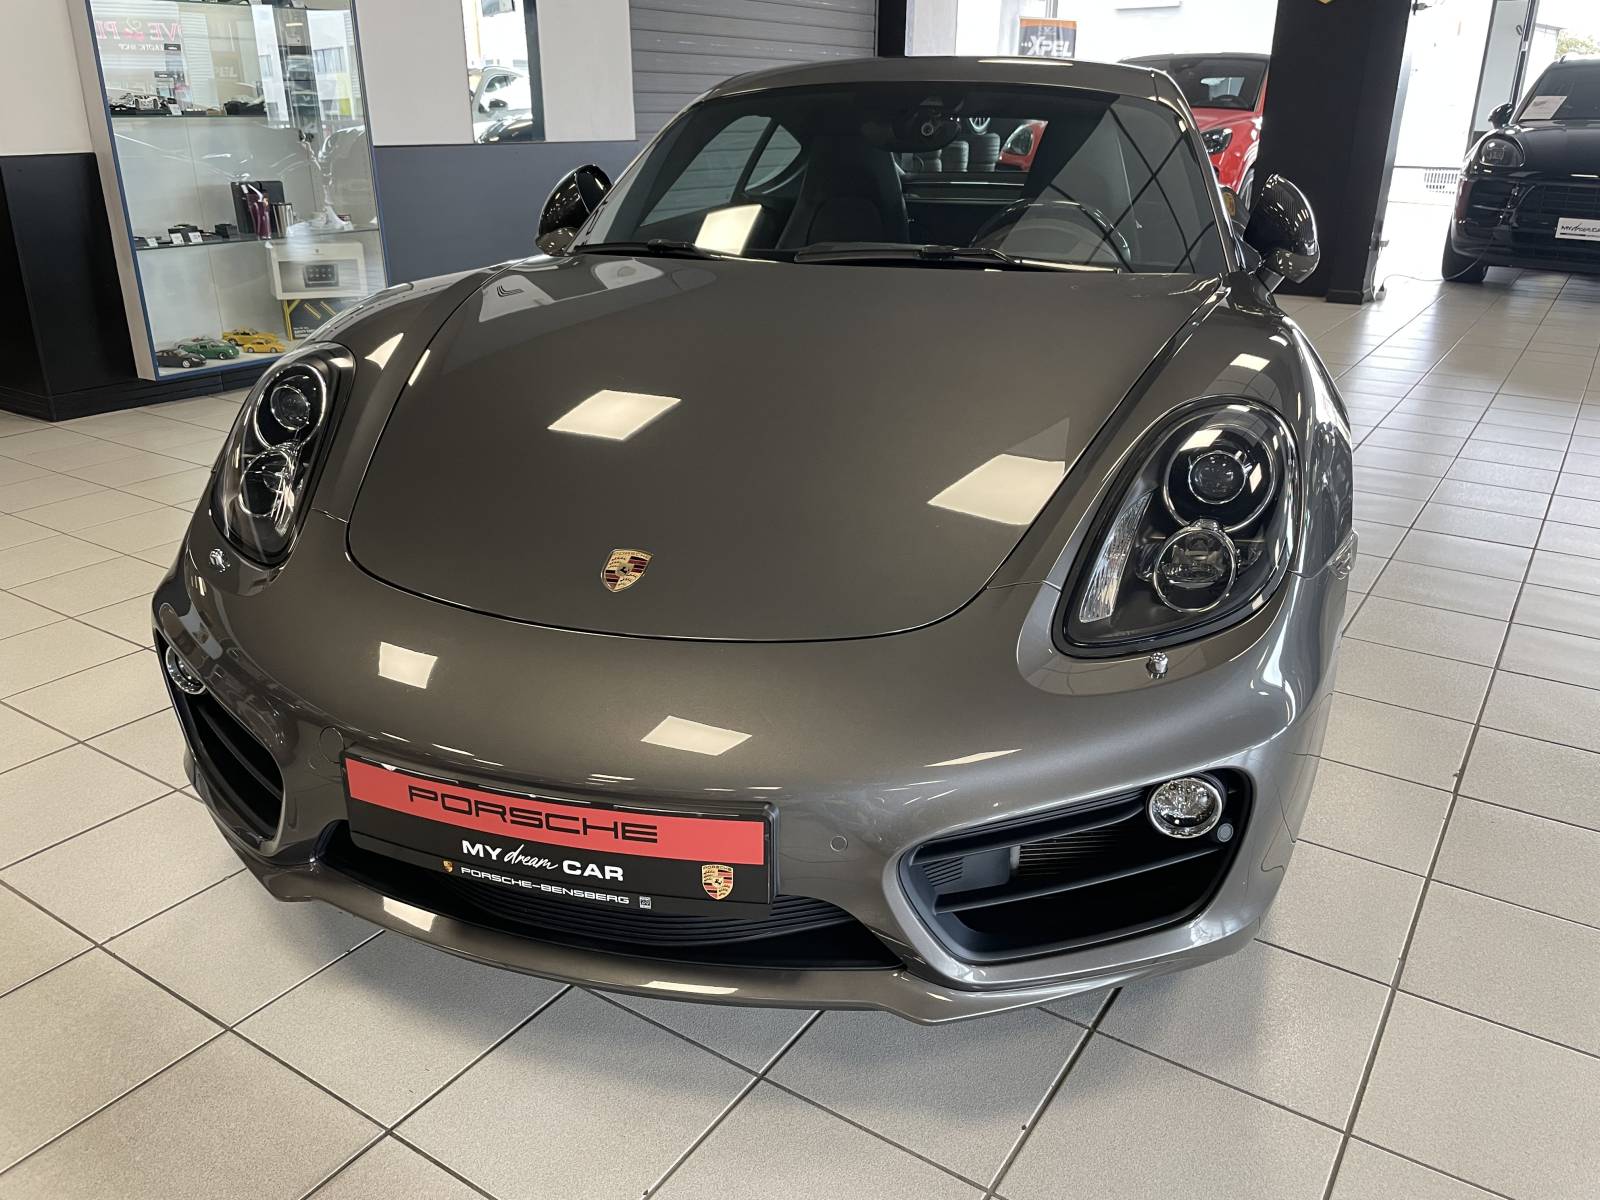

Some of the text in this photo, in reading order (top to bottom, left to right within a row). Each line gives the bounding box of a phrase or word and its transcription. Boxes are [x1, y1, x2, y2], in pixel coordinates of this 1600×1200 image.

[1027, 35, 1072, 57] XPEL
[408, 785, 657, 843] PORSCHE
[461, 840, 624, 881] MY dream CAR
[461, 867, 629, 904] PORSCHE-BENSBERG
